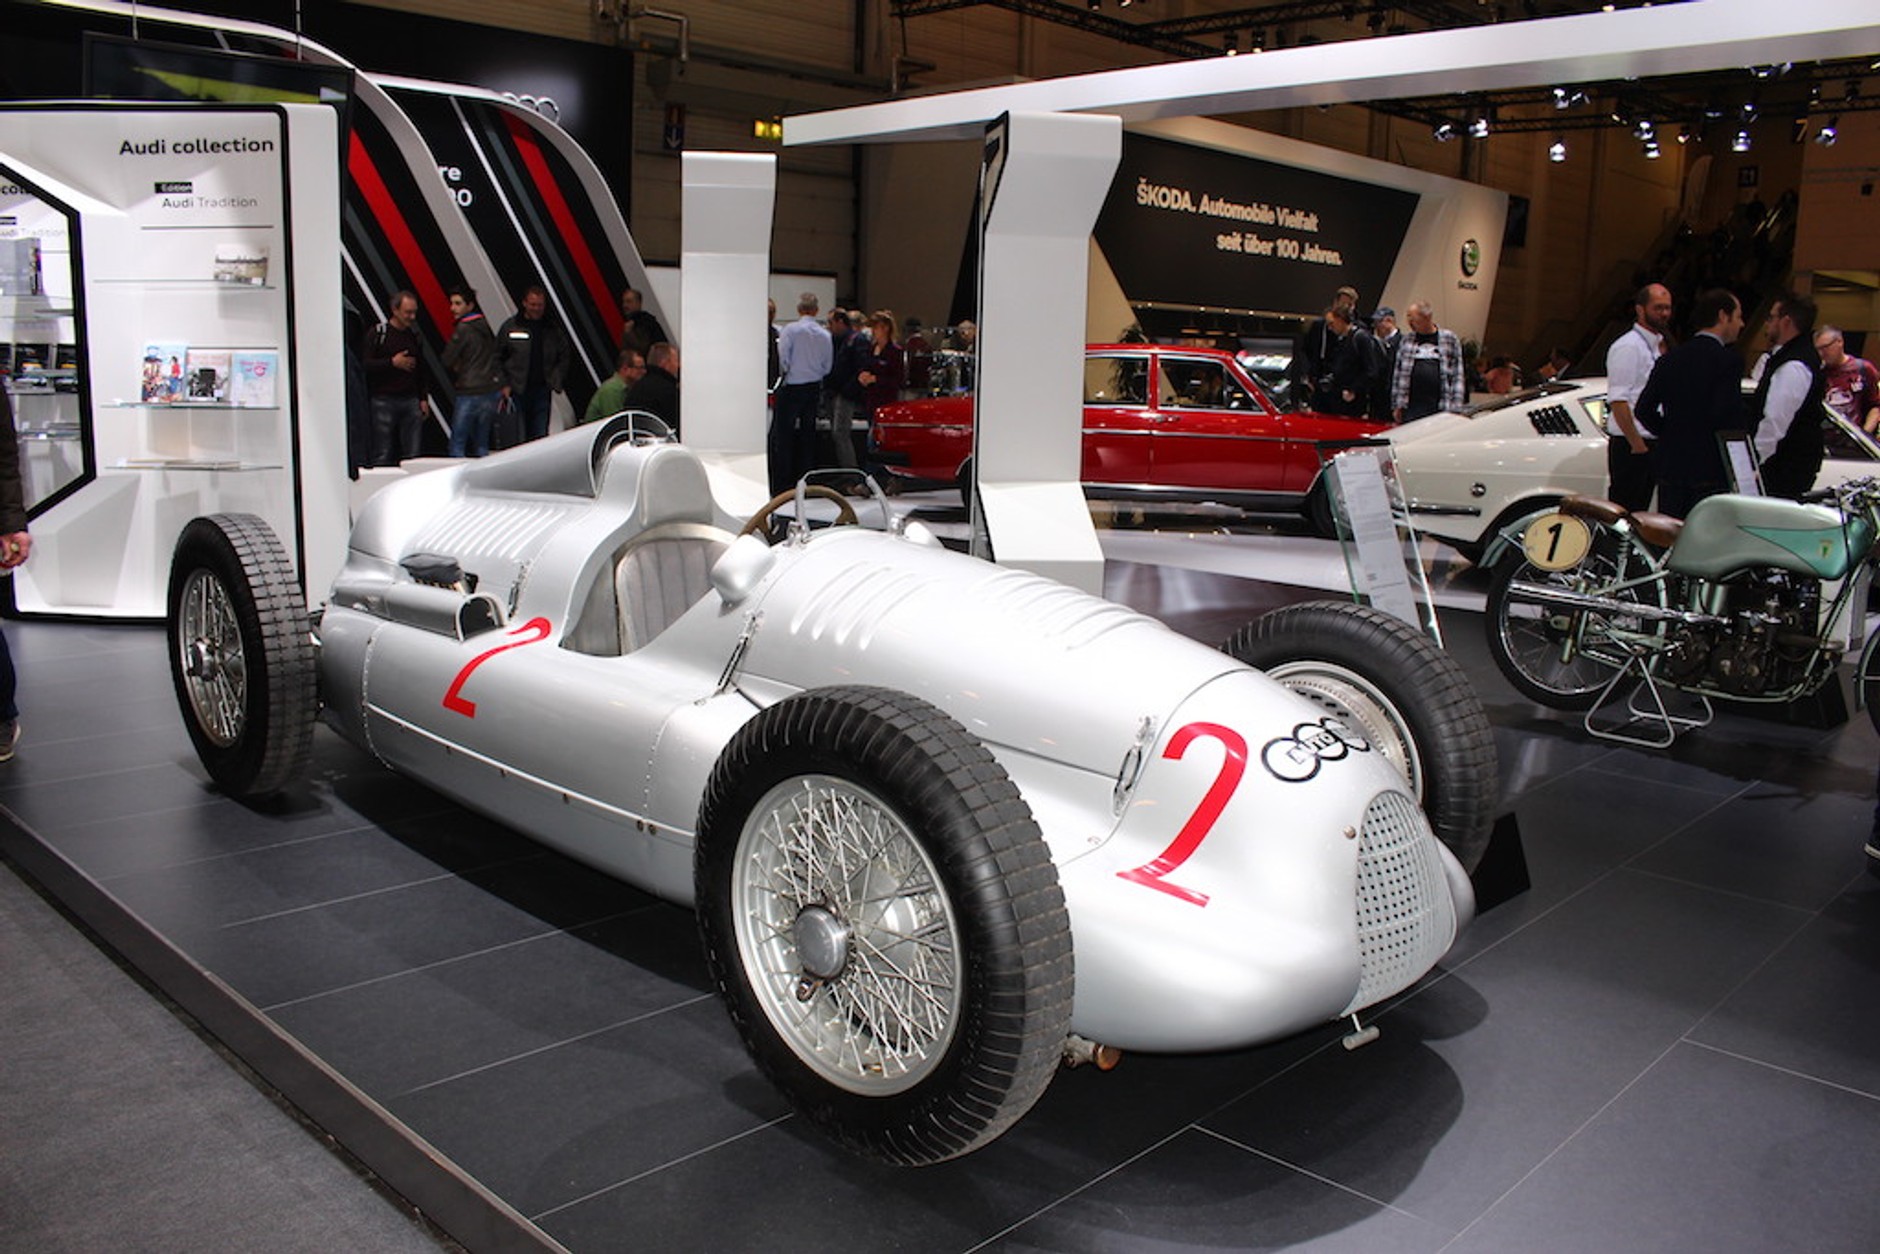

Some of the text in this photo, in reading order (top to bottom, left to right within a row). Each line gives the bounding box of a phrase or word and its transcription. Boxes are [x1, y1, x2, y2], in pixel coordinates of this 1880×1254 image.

[119, 138, 274, 155] Audi collection
[162, 197, 258, 208] Audi Tradition
[1136, 177, 1318, 232] ŠKODA. Automobile Vielfalt
[1216, 232, 1343, 265] seit über 100 Jahren.
[1548, 522, 1563, 563] 1
[442, 617, 551, 719] 2
[1115, 721, 1248, 908] 2
